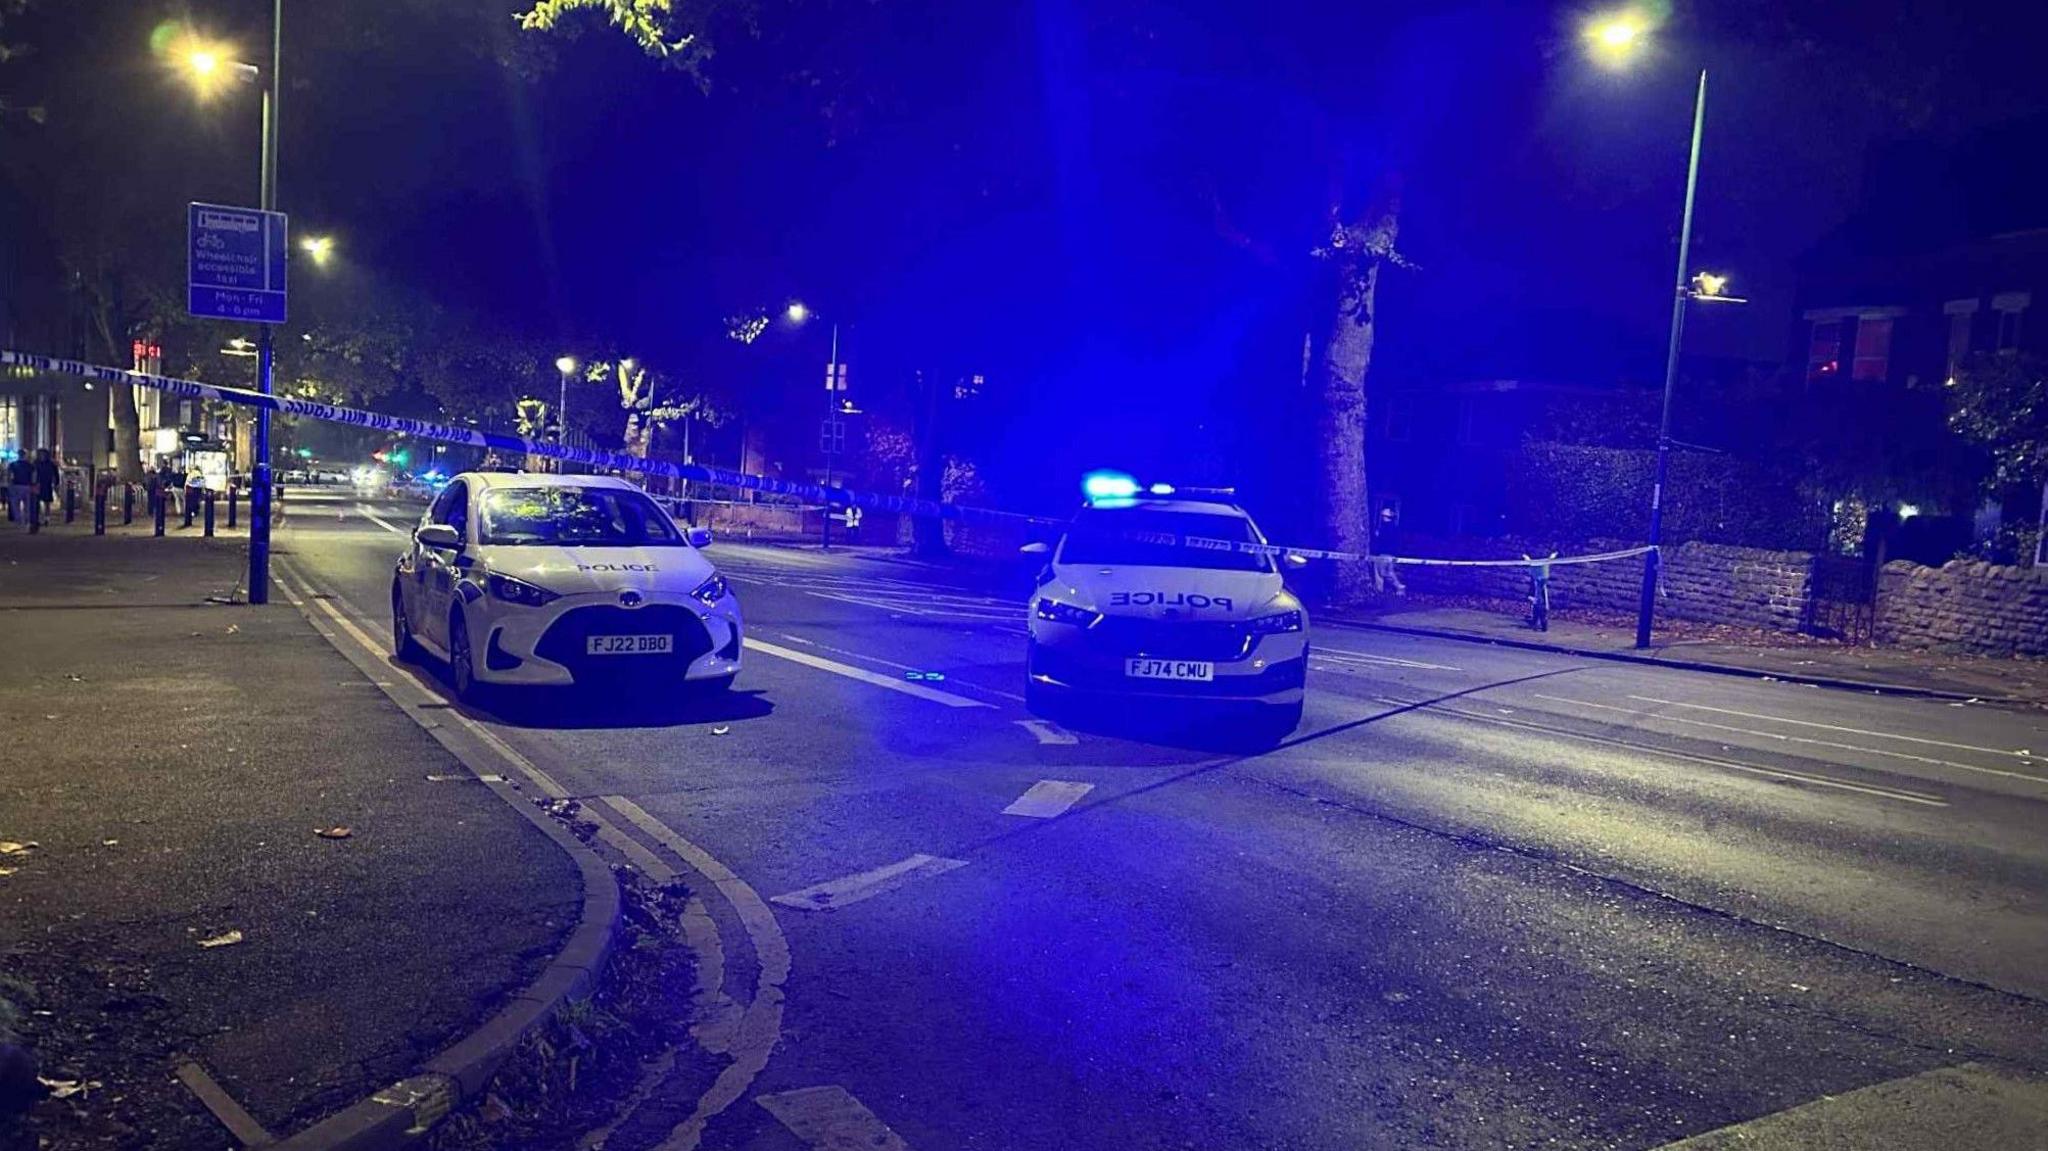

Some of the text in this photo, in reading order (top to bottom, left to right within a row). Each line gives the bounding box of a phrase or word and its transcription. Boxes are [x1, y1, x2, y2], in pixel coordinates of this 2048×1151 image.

[195, 249, 258, 265] Wheelchair
[197, 263, 256, 275] accessible
[577, 564, 660, 573] POLICE
[593, 636, 667, 652] FJ22 DBO
[1131, 660, 1208, 678] FJ74 CMU
